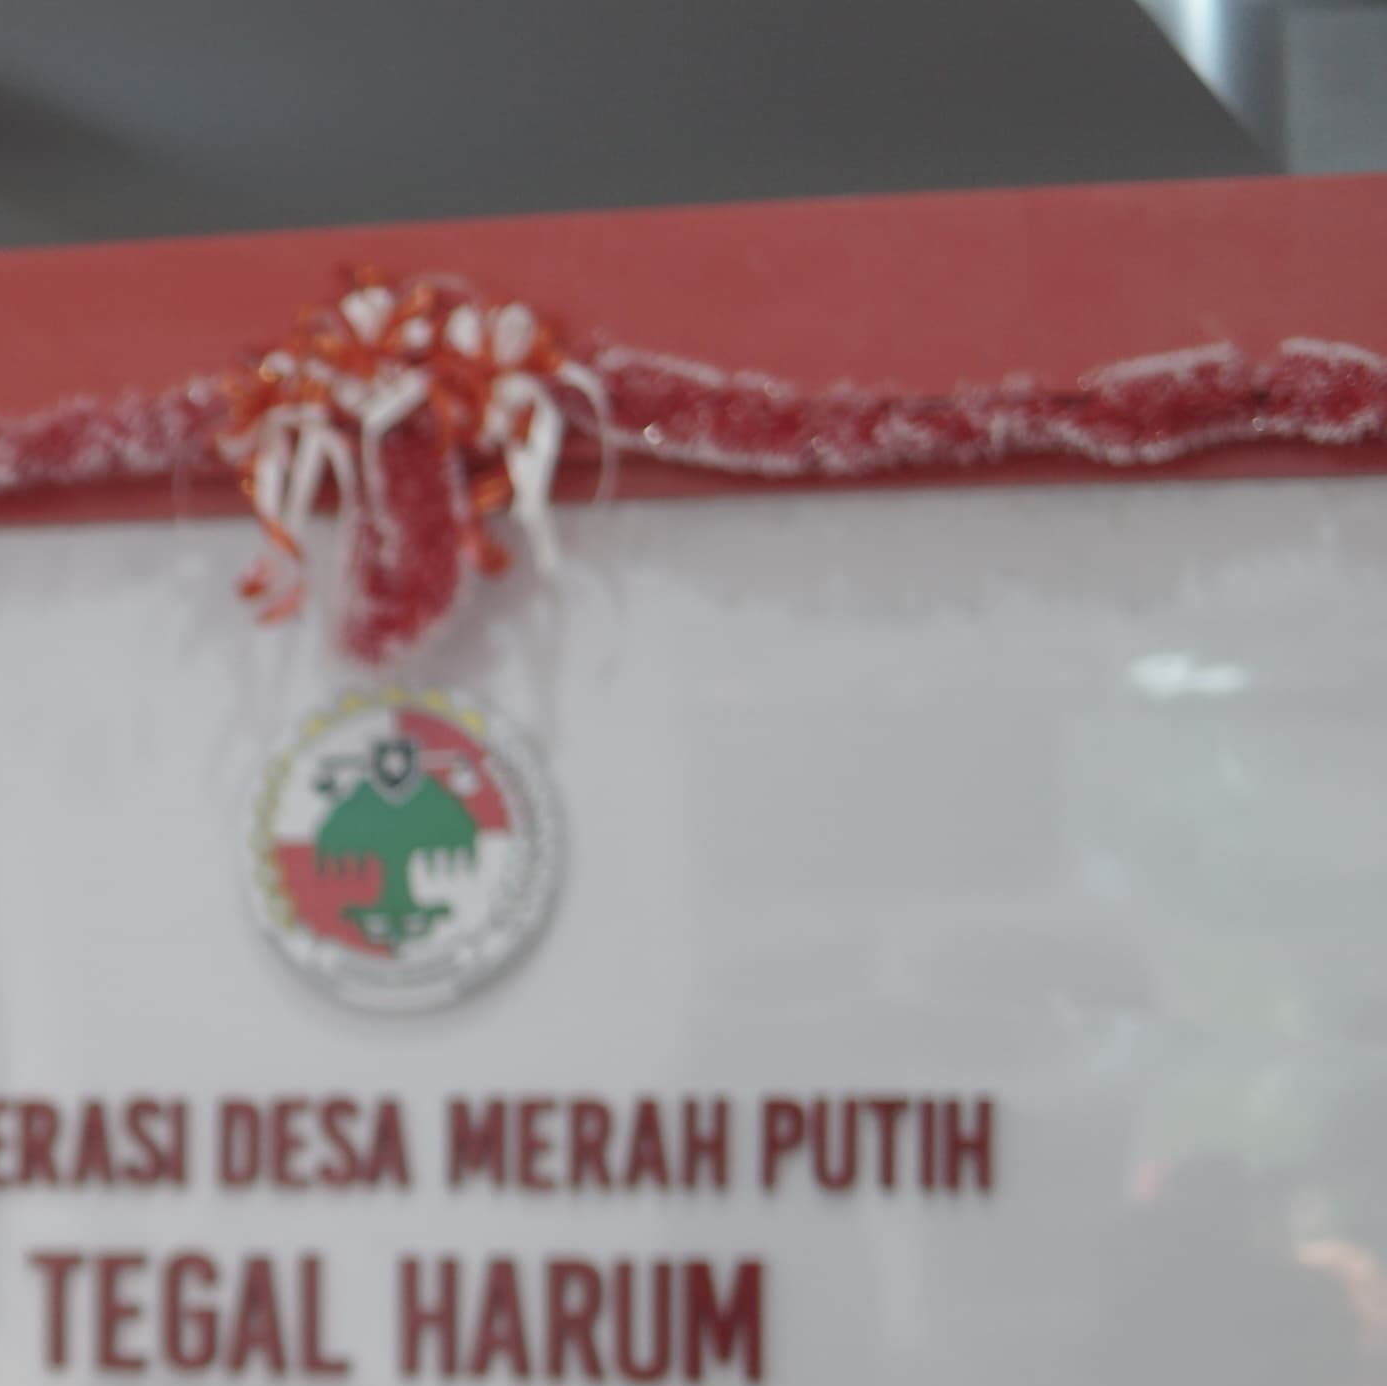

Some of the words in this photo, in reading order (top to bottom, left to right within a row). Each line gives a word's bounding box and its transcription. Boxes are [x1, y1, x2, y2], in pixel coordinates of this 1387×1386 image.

[219, 1098, 410, 1189] DESA
[448, 1098, 730, 1190] MERAH
[760, 1099, 993, 1192] PUTIH
[34, 1253, 349, 1376] TEGAL
[399, 1258, 764, 1384] HARUM
